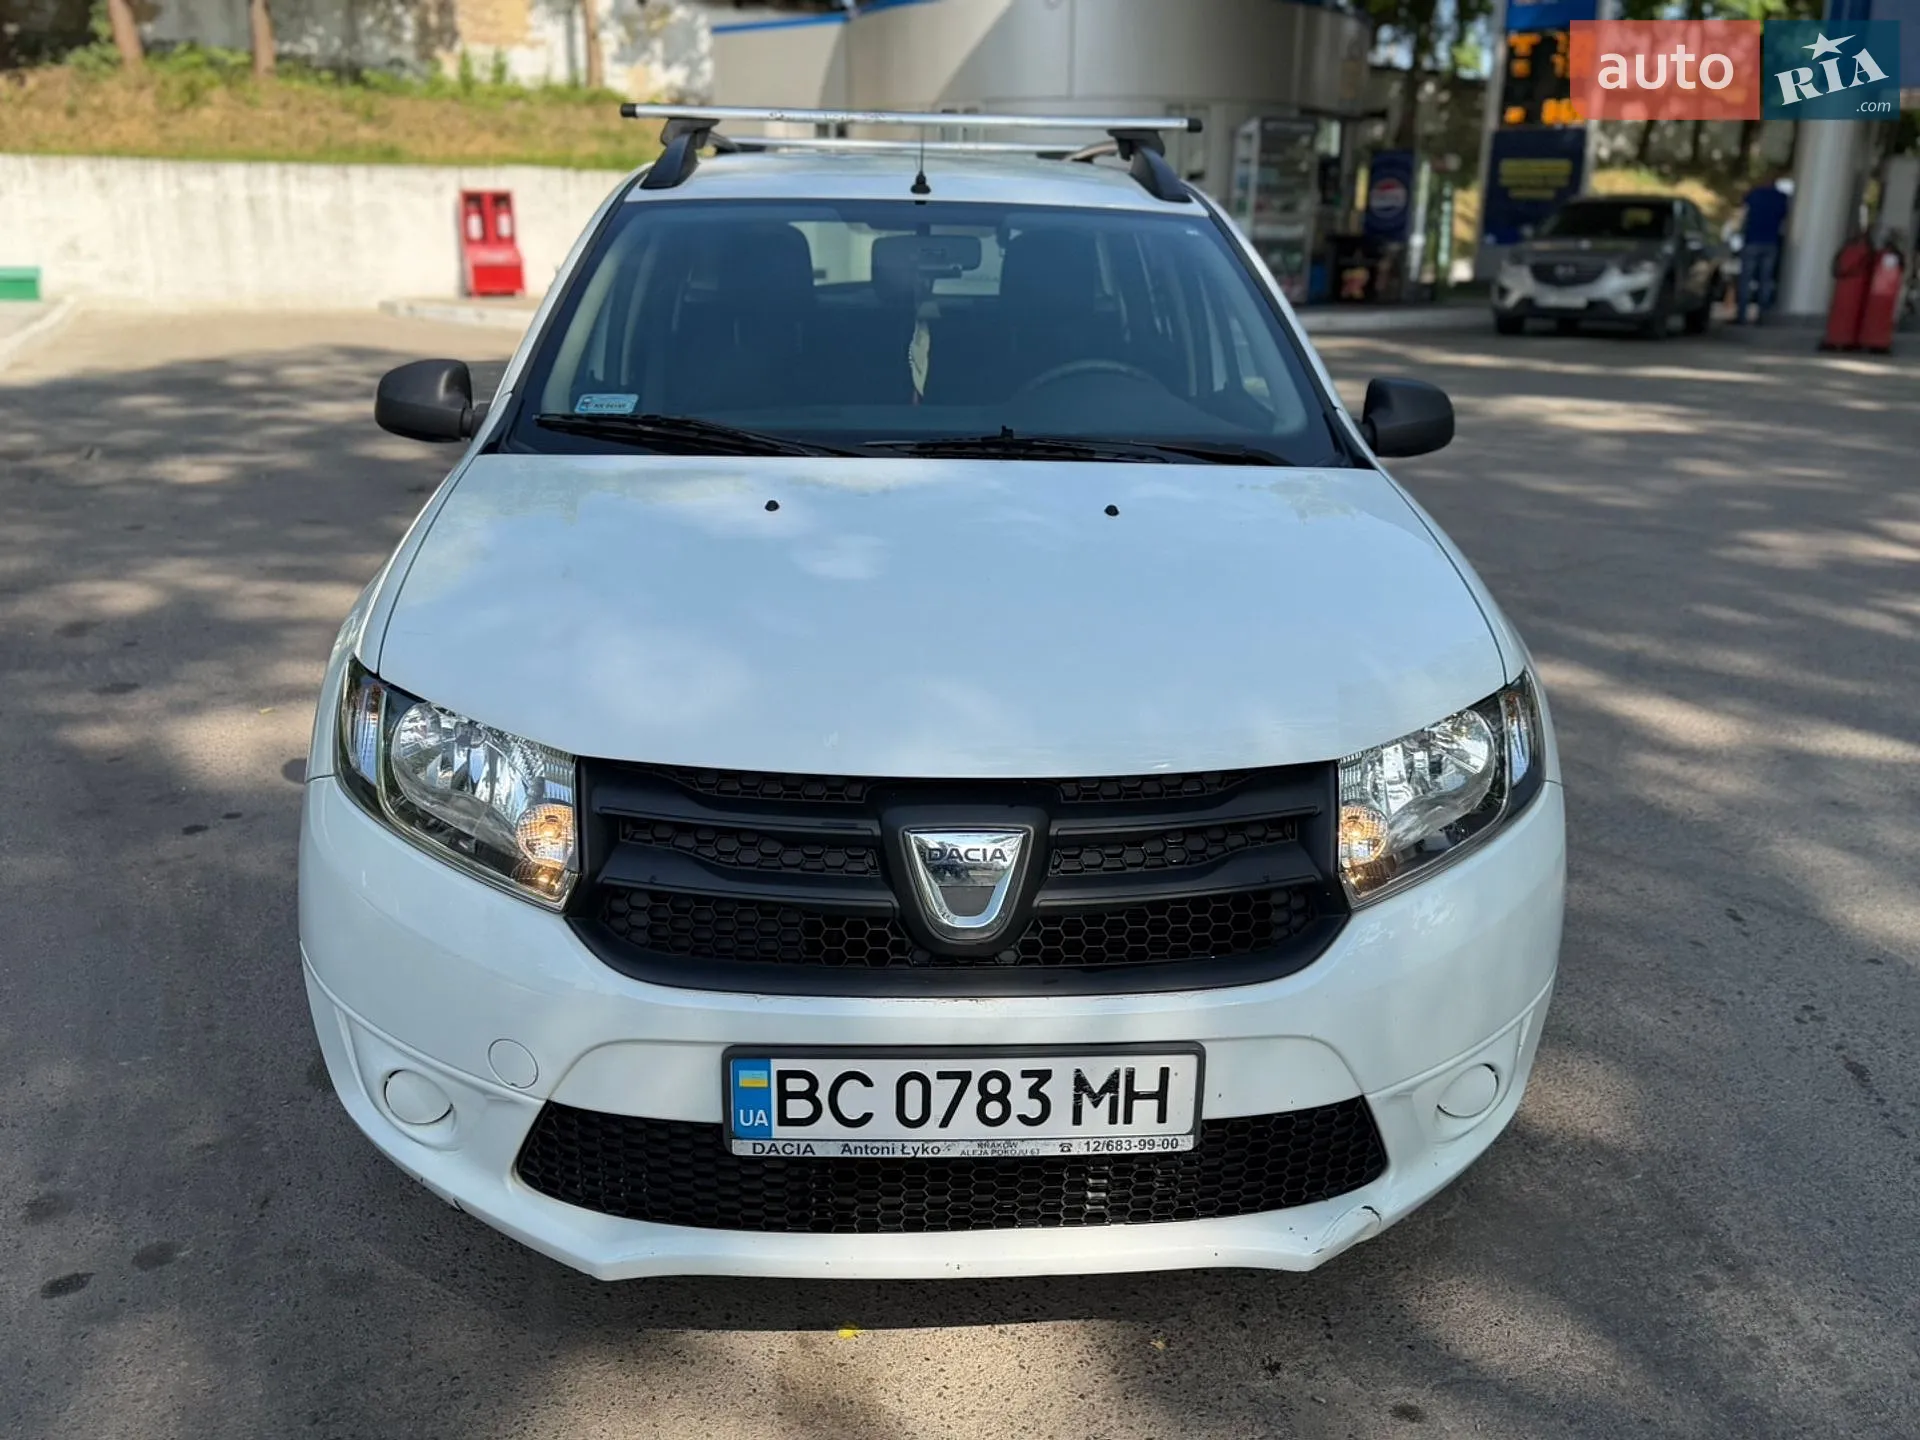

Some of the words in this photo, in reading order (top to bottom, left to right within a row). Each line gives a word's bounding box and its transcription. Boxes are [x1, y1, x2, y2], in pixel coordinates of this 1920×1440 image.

[926, 847, 1008, 863] DACIA
[776, 1069, 875, 1128] BC
[895, 1068, 1053, 1129] 0783
[1072, 1066, 1170, 1126] MH
[739, 1109, 769, 1127] UA
[752, 1142, 816, 1156] DACIA
[840, 1142, 896, 1156] Antoni
[900, 1142, 941, 1159] Łyko
[1085, 1137, 1179, 1153] 12/683-99-00
